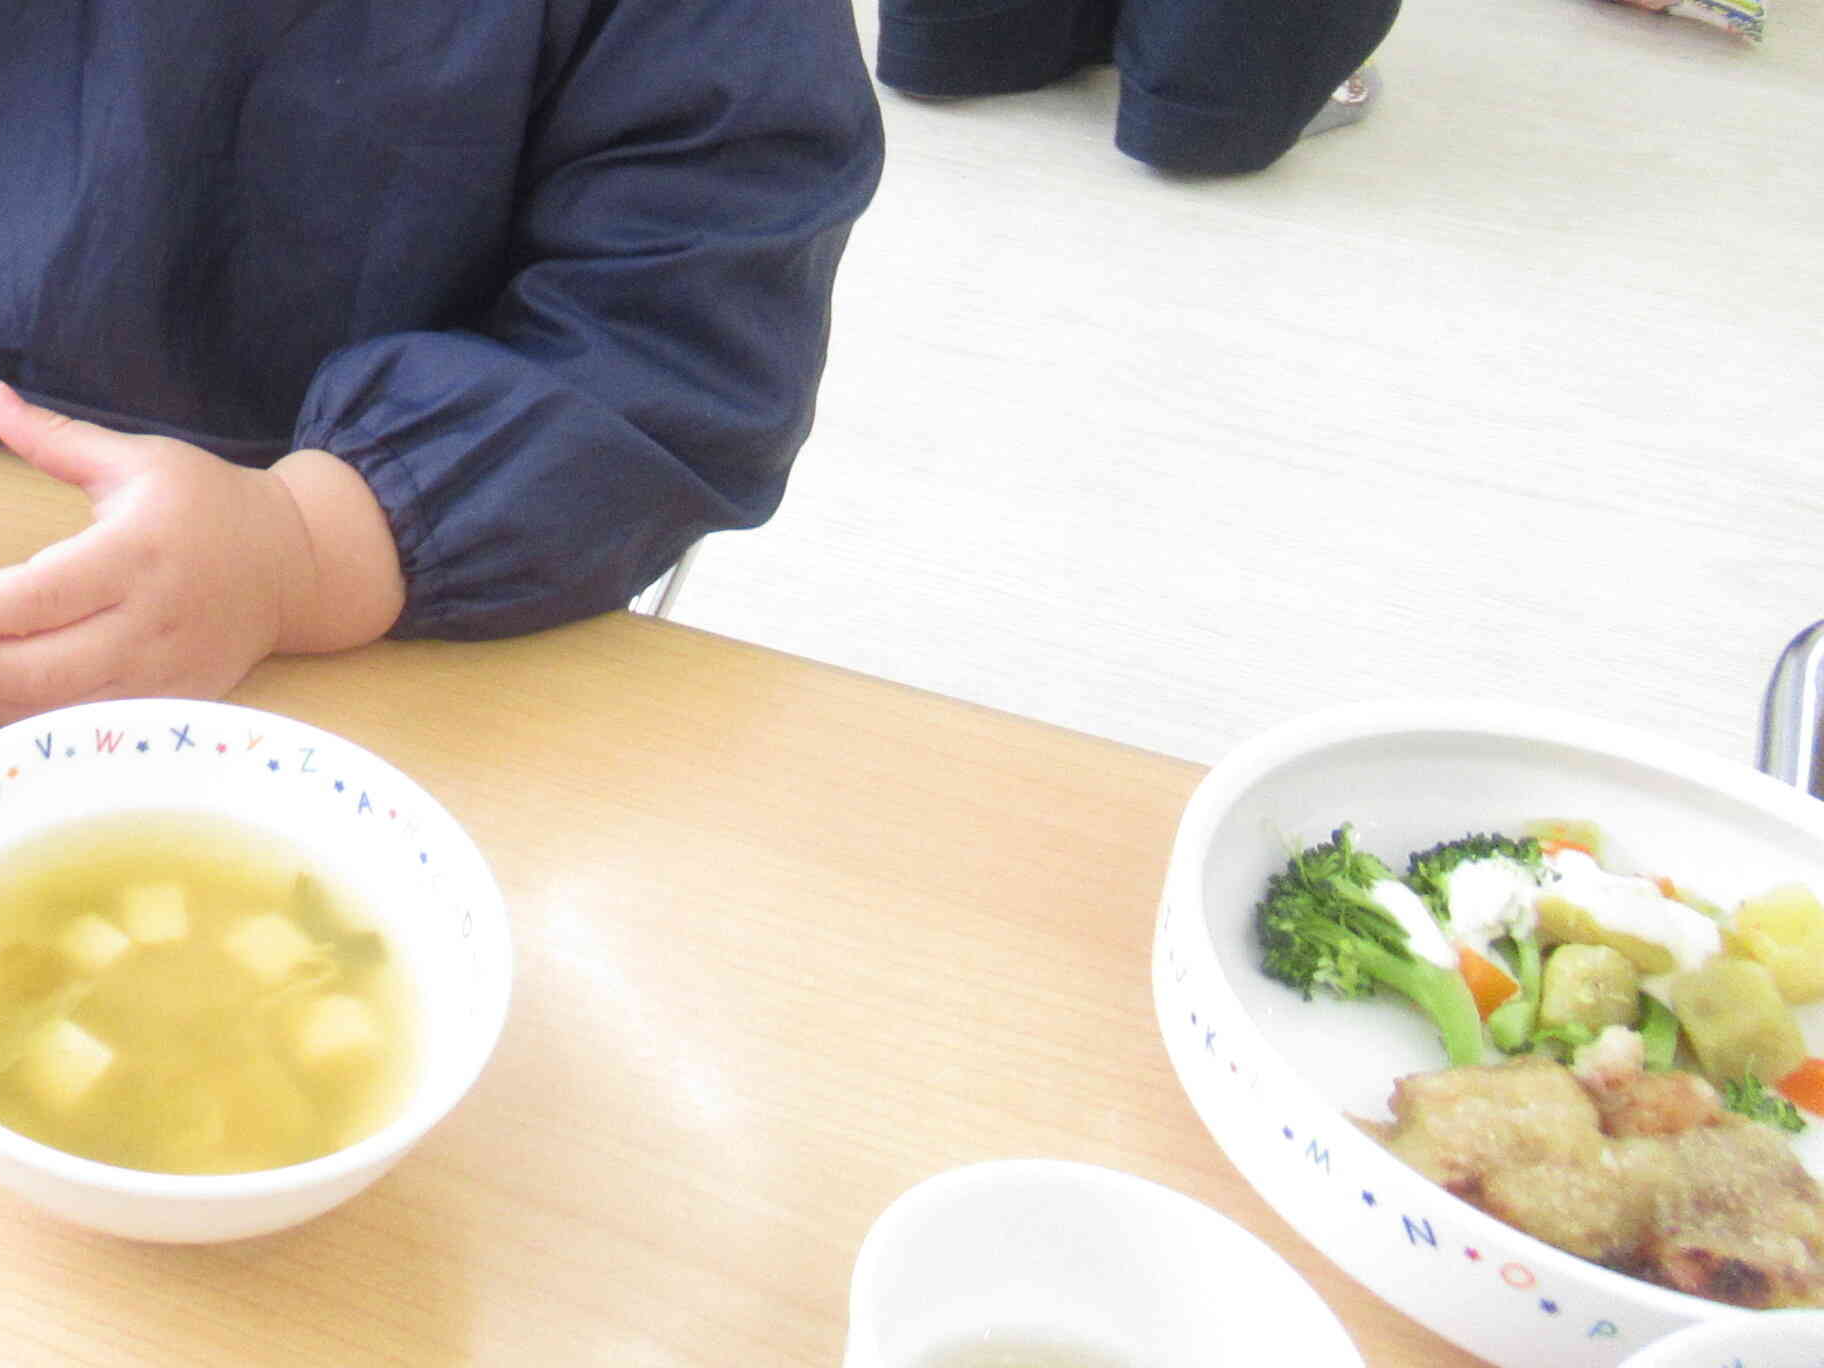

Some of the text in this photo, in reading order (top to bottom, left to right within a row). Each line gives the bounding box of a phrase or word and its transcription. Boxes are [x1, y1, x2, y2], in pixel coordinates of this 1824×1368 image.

[35, 731, 53, 760] V
[95, 728, 125, 754] W
[169, 723, 196, 752] X
[246, 728, 264, 751] Y
[298, 746, 319, 773] Z
[356, 789, 375, 816] A
[1205, 1024, 1217, 1057] K
[1304, 1137, 1331, 1177] M
[1400, 1212, 1439, 1251] N
[1498, 1261, 1539, 1291] O
[1587, 1319, 1619, 1342] P
